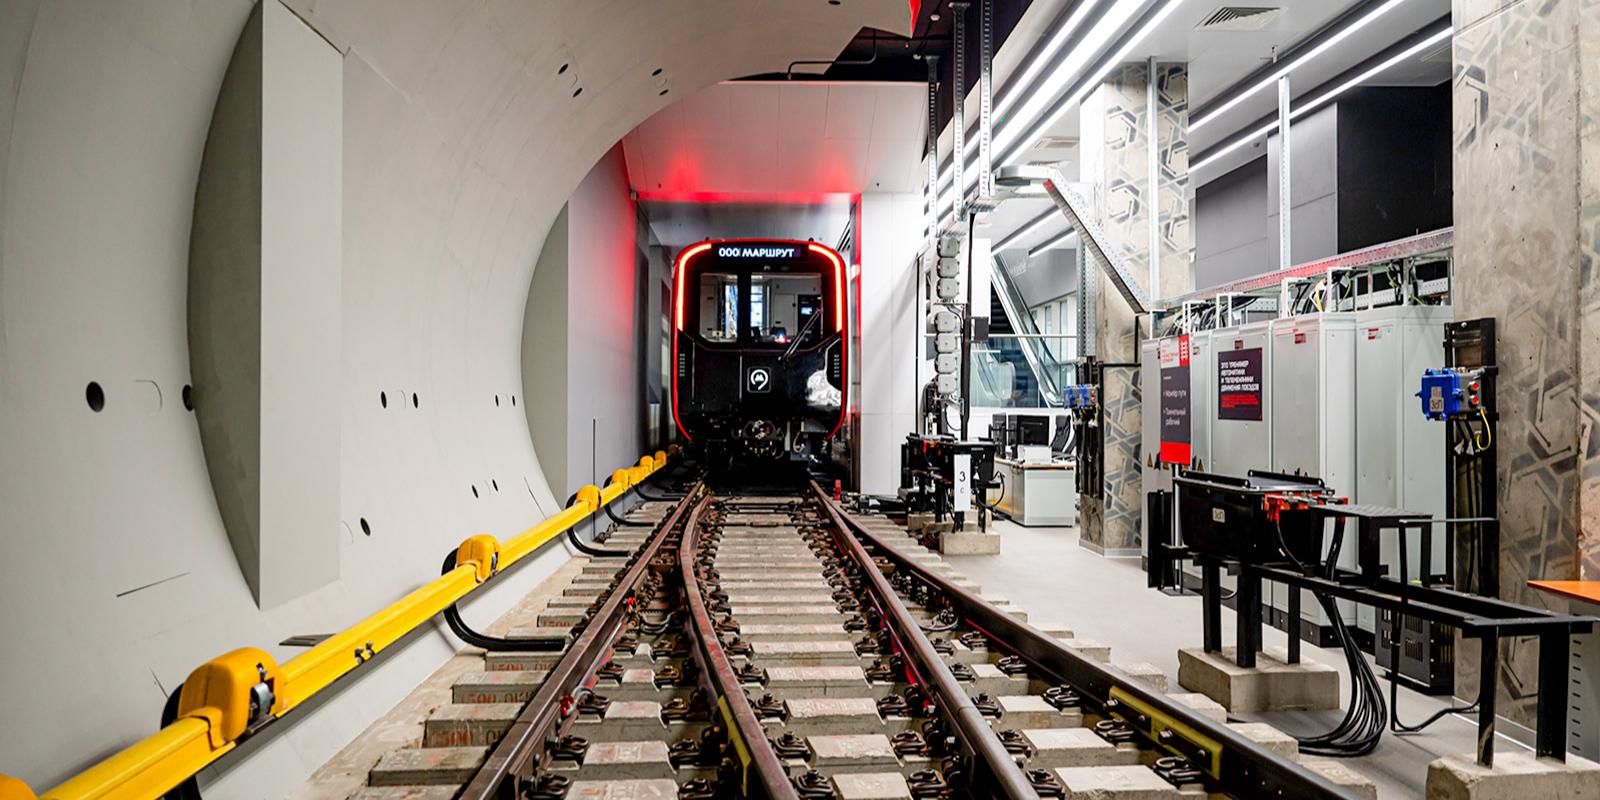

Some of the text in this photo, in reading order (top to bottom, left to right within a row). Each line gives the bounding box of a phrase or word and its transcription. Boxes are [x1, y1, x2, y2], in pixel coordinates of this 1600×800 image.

[718, 247, 795, 258] 000 МАРШРУТ
[959, 470, 966, 482] 3
